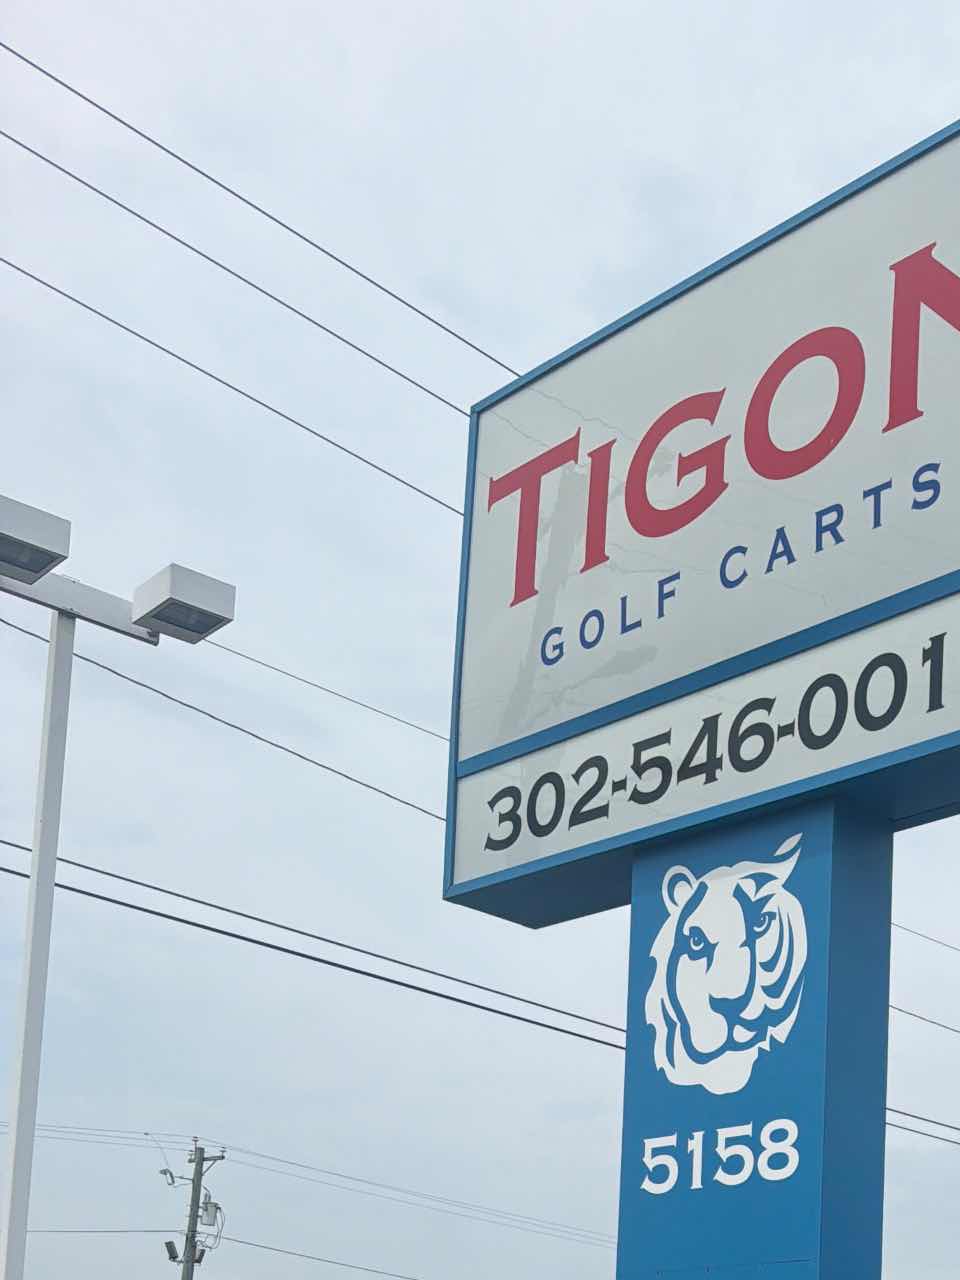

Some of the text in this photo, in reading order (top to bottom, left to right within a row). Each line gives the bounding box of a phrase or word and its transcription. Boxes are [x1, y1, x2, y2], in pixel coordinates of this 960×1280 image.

[541, 463, 941, 666] GOLF CARTS
[640, 1118, 800, 1195] 5158
